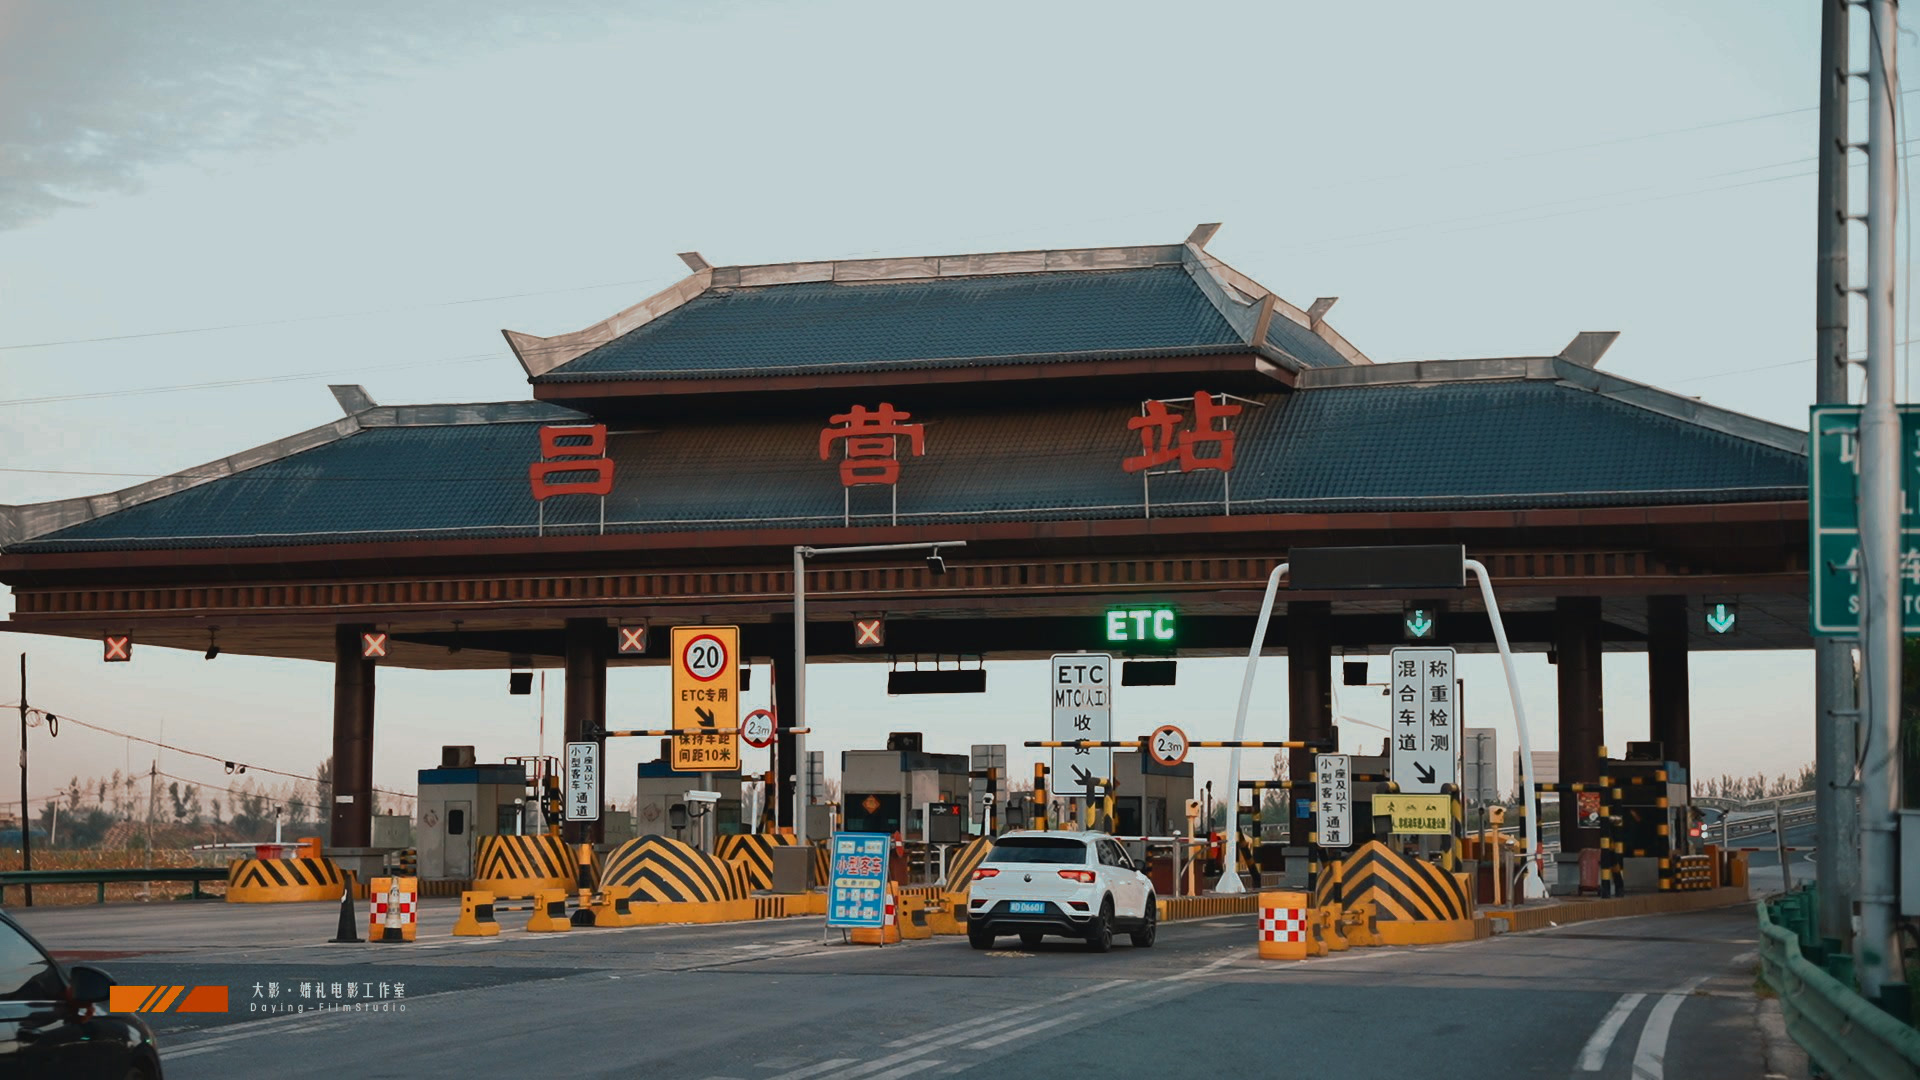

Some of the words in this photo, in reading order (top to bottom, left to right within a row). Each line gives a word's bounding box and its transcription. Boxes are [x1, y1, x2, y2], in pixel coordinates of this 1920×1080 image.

[529, 391, 1242, 501] 吕营站
[1107, 609, 1174, 641] ETC
[692, 645, 719, 669] 20
[1058, 665, 1103, 684] ETC
[681, 688, 728, 702] ETC专用
[1398, 660, 1417, 752] 混合车道
[1429, 660, 1449, 752] 称重检测
[748, 721, 770, 736] 2.3m
[679, 748, 731, 763] 间距10米
[1157, 738, 1182, 752] 2.3m
[571, 747, 581, 790] 小型客车
[584, 746, 594, 790] 7座及以下
[1320, 758, 1333, 812] 小型客车
[1335, 758, 1347, 812] 7座及以下
[576, 792, 588, 816] 通道
[1326, 816, 1340, 843] 通道
[836, 856, 882, 876] 小型客车
